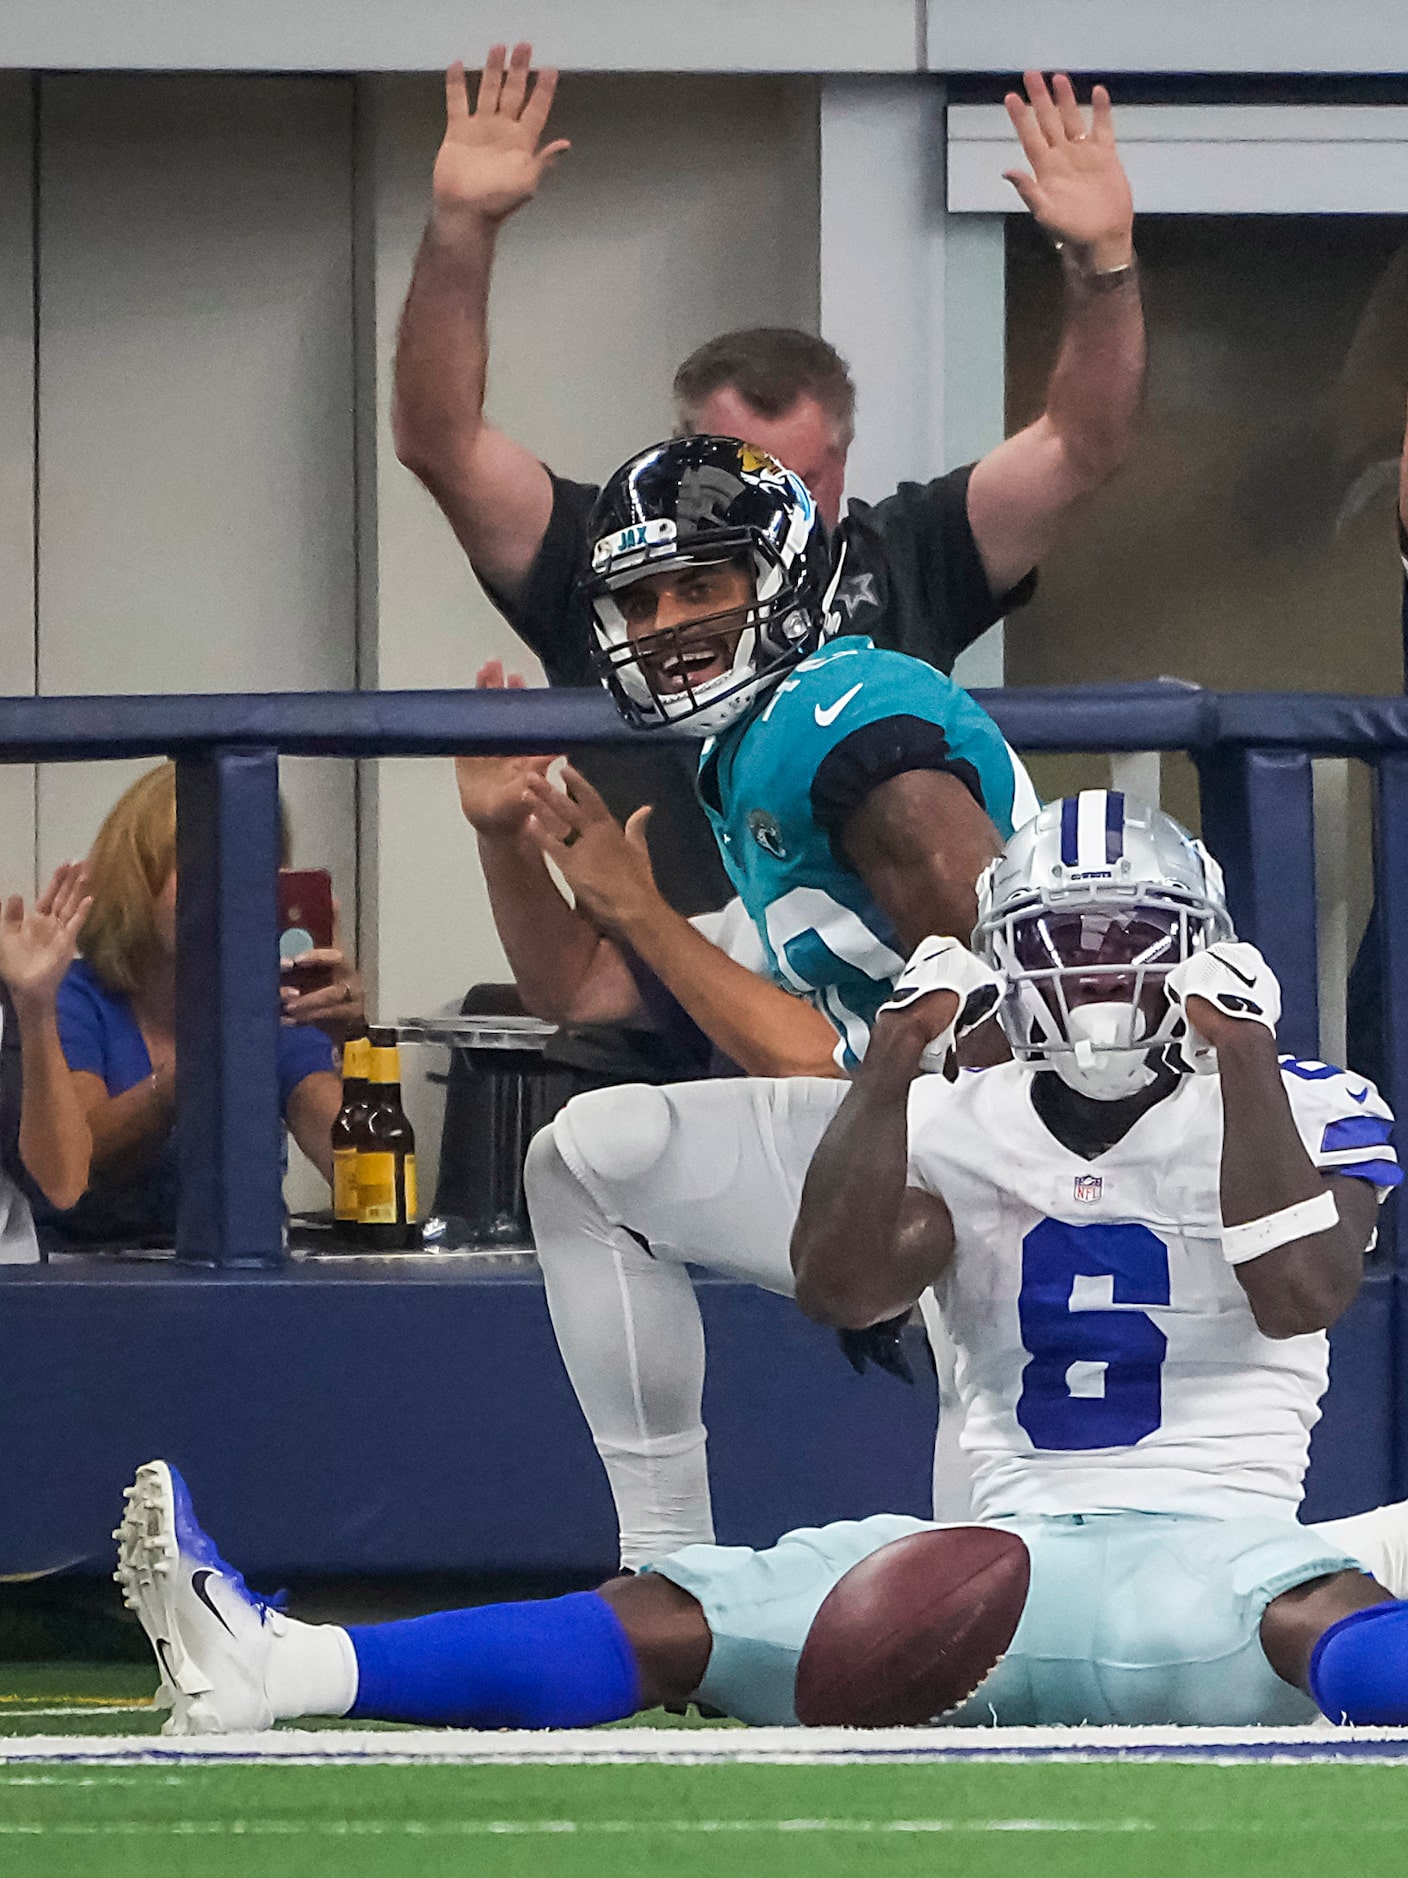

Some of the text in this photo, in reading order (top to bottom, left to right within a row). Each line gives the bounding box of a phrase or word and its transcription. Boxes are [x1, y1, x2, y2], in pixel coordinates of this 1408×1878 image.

[618, 526, 648, 551] JAX
[1077, 1185, 1099, 1201] NFL
[1016, 1217, 1170, 1451] 6
